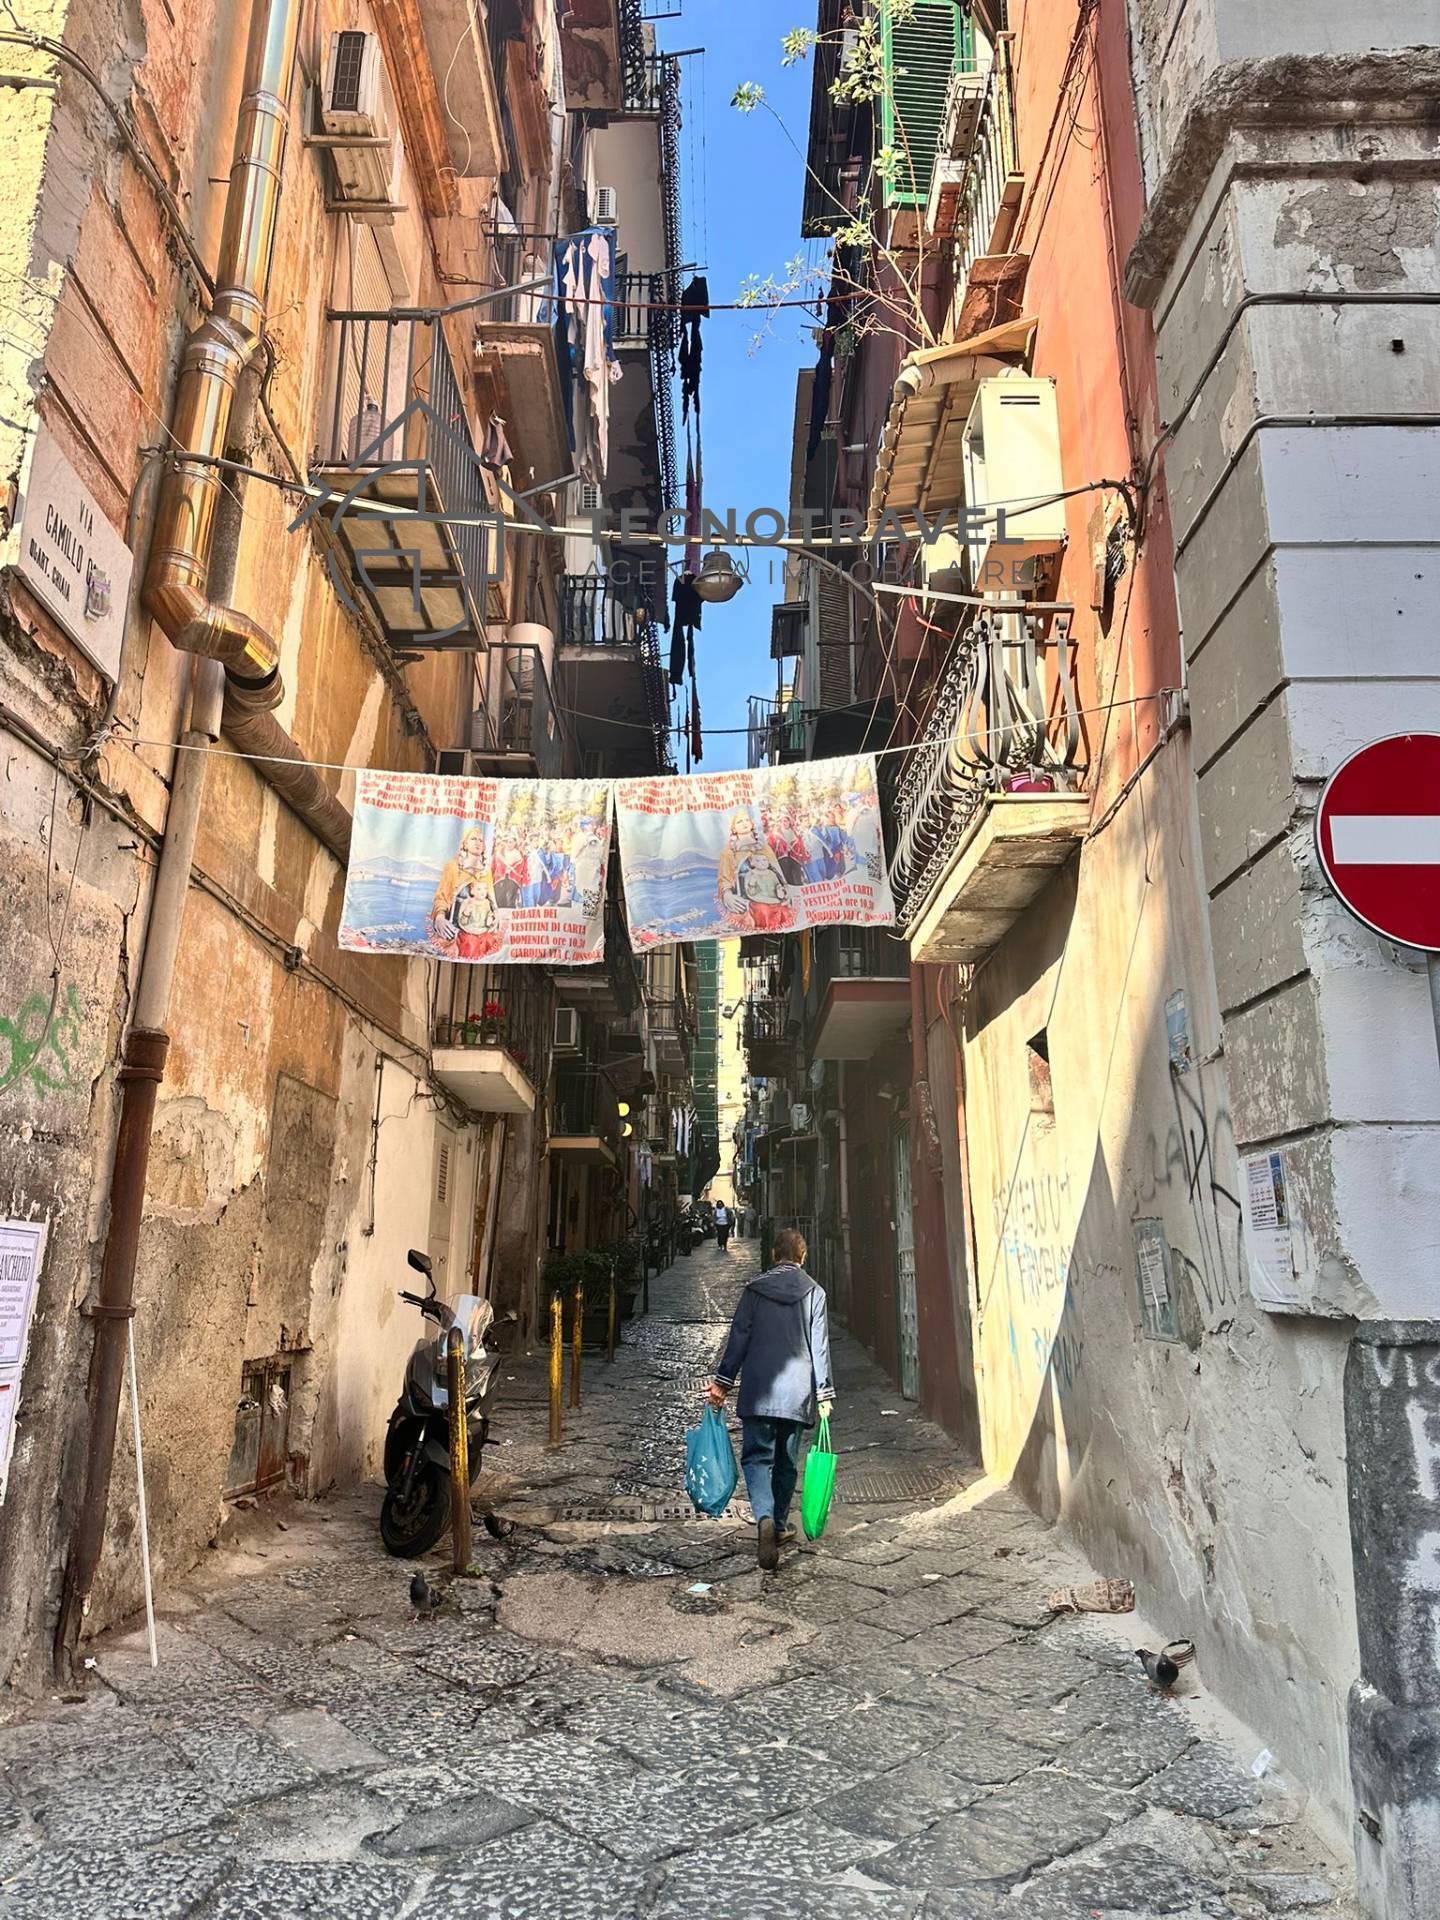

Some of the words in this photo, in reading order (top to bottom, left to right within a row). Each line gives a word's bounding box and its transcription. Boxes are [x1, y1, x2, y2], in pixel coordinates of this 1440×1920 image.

[79, 499, 94, 537] VIA
[45, 504, 84, 574] CAMILLO
[29, 538, 51, 578] QUART.
[51, 565, 71, 603] CHIAIA
[361, 796, 410, 812] MADONNA
[625, 802, 671, 815] MADONNA
[800, 881, 832, 895] SFILATA
[511, 908, 541, 919] SFILATA
[543, 908, 558, 919] DEI
[510, 922, 549, 932] VESTITINI
[551, 922, 561, 932] DI
[509, 935, 550, 945] DOMENICA
[552, 937, 567, 946] ore
[510, 948, 546, 959] GIARDINI
[546, 948, 562, 960] VIA
